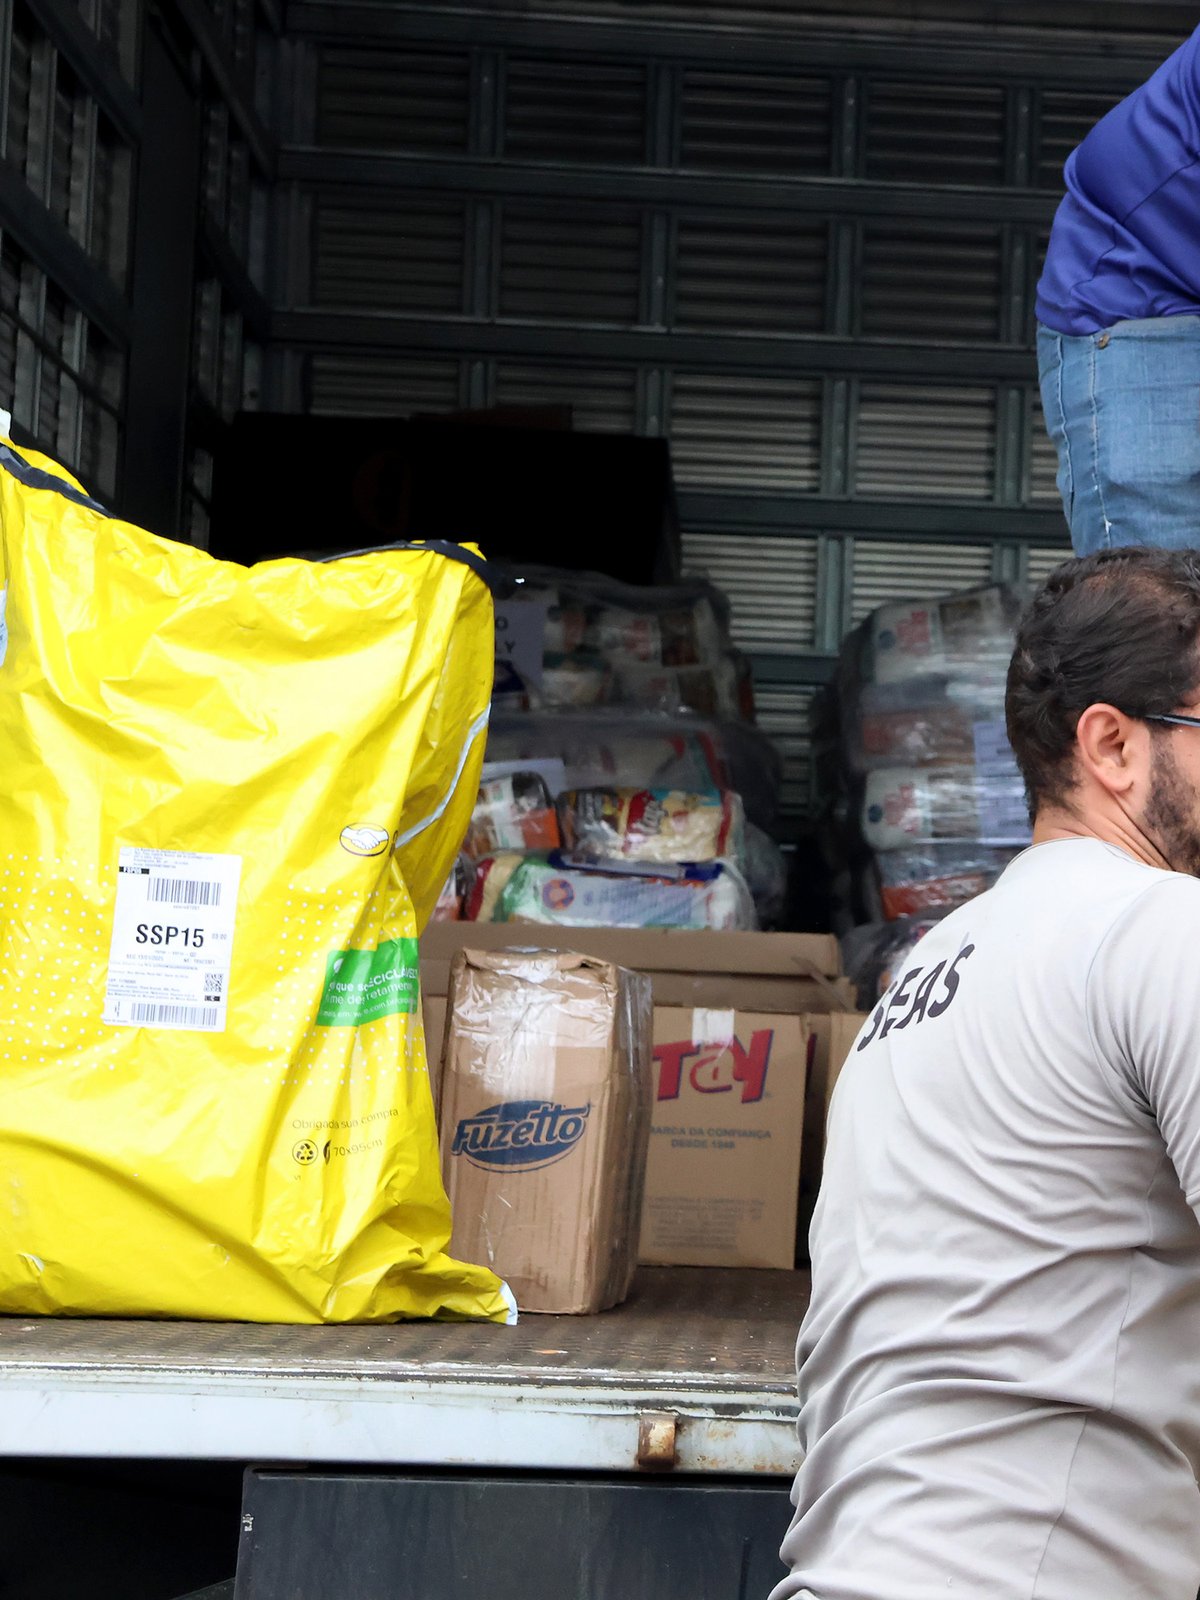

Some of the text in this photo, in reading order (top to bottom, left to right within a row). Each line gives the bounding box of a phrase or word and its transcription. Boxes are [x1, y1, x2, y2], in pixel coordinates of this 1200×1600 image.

[136, 924, 204, 948] SSP15
[857, 943, 975, 1052] SEAS
[450, 1102, 592, 1157] Fuzetto
